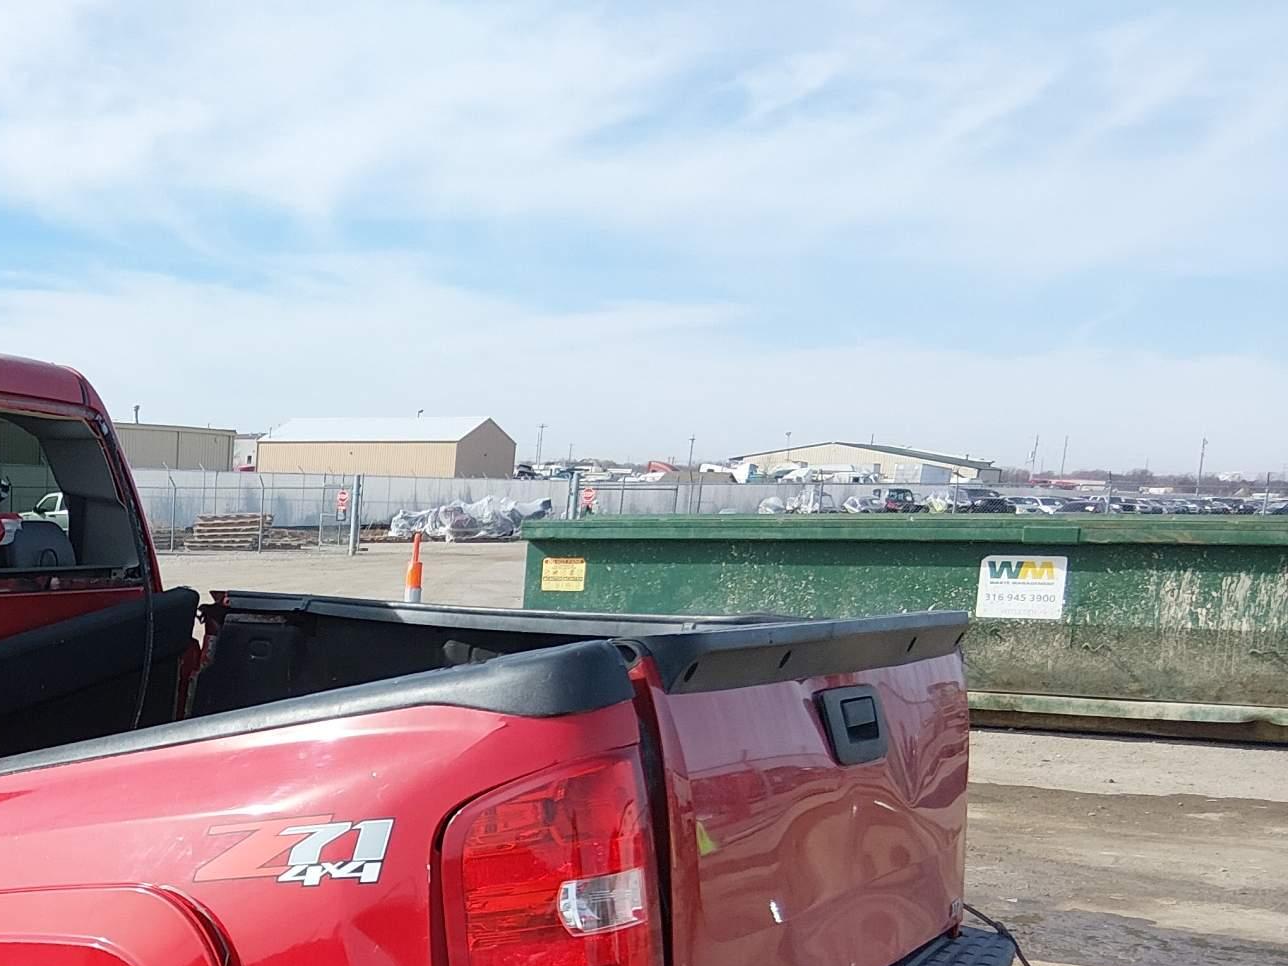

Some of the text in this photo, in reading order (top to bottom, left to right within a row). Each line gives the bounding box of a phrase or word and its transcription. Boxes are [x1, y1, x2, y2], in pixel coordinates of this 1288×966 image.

[988, 561, 1055, 580] WM
[985, 593, 1056, 602] 316 945 3900
[192, 813, 396, 883] Z71
